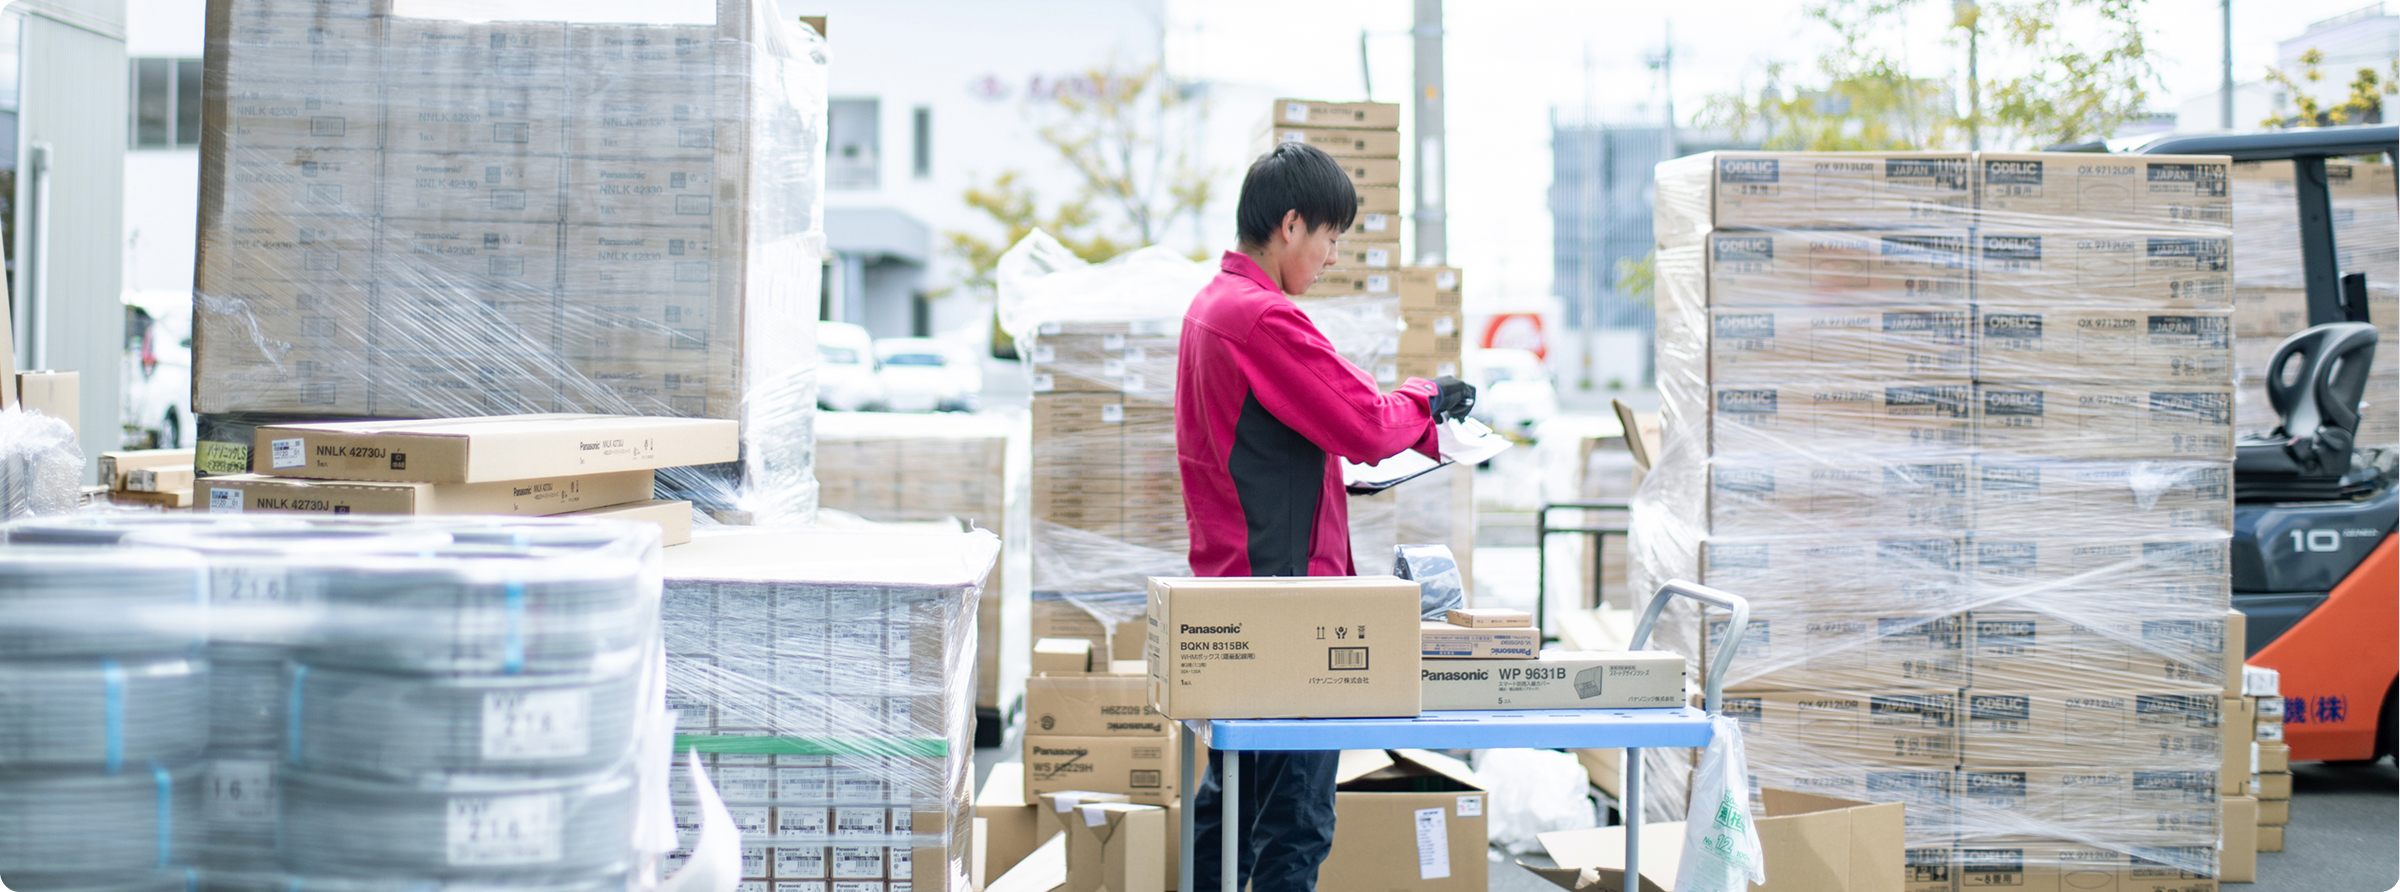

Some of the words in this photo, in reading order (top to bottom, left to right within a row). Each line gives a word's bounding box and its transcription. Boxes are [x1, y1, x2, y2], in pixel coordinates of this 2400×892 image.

[237, 106, 265, 116] NNLK
[419, 112, 450, 122] NNLK
[416, 165, 462, 173] Panasonic
[1725, 162, 1772, 174] ODELIC
[1815, 163, 1829, 171] OX
[1893, 166, 1928, 176] JAPAN
[1991, 163, 2037, 175] ODELIC
[2078, 166, 2093, 174] OX
[601, 171, 646, 180] Panasonic
[2154, 170, 2189, 180] JAPAN
[600, 185, 630, 194] NNLK
[633, 185, 662, 194] 42330
[414, 231, 460, 240] Panasonic
[598, 237, 645, 247] Panasonic
[1719, 241, 1766, 251] ODELIC
[1810, 241, 1825, 250] OX
[1989, 239, 2036, 250] ODELIC
[2077, 241, 2092, 250] OX
[2154, 245, 2189, 255] JAPAN
[598, 251, 629, 261] NNLK
[1721, 317, 1768, 329] ODELIC
[1811, 318, 1826, 326] OX
[1891, 319, 1926, 330] JAPAN
[1990, 317, 2037, 329] ODELIC
[2078, 319, 2093, 328] OX
[2096, 319, 2136, 328] 9712LDR
[2155, 322, 2190, 333] JAPAN
[1723, 392, 1771, 404] ODELIC
[1814, 392, 1829, 401] OX
[1990, 394, 2038, 406] ODELIC
[2079, 396, 2094, 404] OX
[580, 440, 600, 451] Panasonic
[316, 446, 347, 457] NNLK
[350, 446, 386, 459] 42730J
[513, 487, 532, 497] Panasonic
[257, 498, 288, 510] NNLK
[291, 499, 329, 511] 42730J
[2290, 529, 2340, 552] 10
[1180, 623, 1241, 634] Panasonic
[1983, 623, 2030, 635] ODELIC
[1180, 642, 1210, 650] BQKN
[1212, 641, 1250, 650] 8315BK
[1421, 669, 1489, 681] Panasonic
[1499, 668, 1521, 680] WP
[1525, 667, 1566, 680] 9631B
[1309, 677, 1370, 685] パナソニック株式会社
[1721, 700, 1756, 711] DELIC
[1798, 700, 1814, 709] OX
[1879, 702, 1915, 712] JAPAN
[1976, 698, 2024, 709] ODELIC
[2066, 699, 2080, 708] OX
[1101, 706, 1140, 715] 60229H
[1107, 723, 1161, 732] Panasonic
[1033, 746, 1088, 755] Panasonic
[1033, 763, 1051, 772] WS
[1054, 763, 1093, 772] 60229H
[1973, 775, 2020, 787] ODELIC
[2063, 776, 2078, 784] OX
[2142, 778, 2176, 787] JAPAN
[1715, 834, 1734, 854] 12
[2060, 852, 2074, 860] OX
